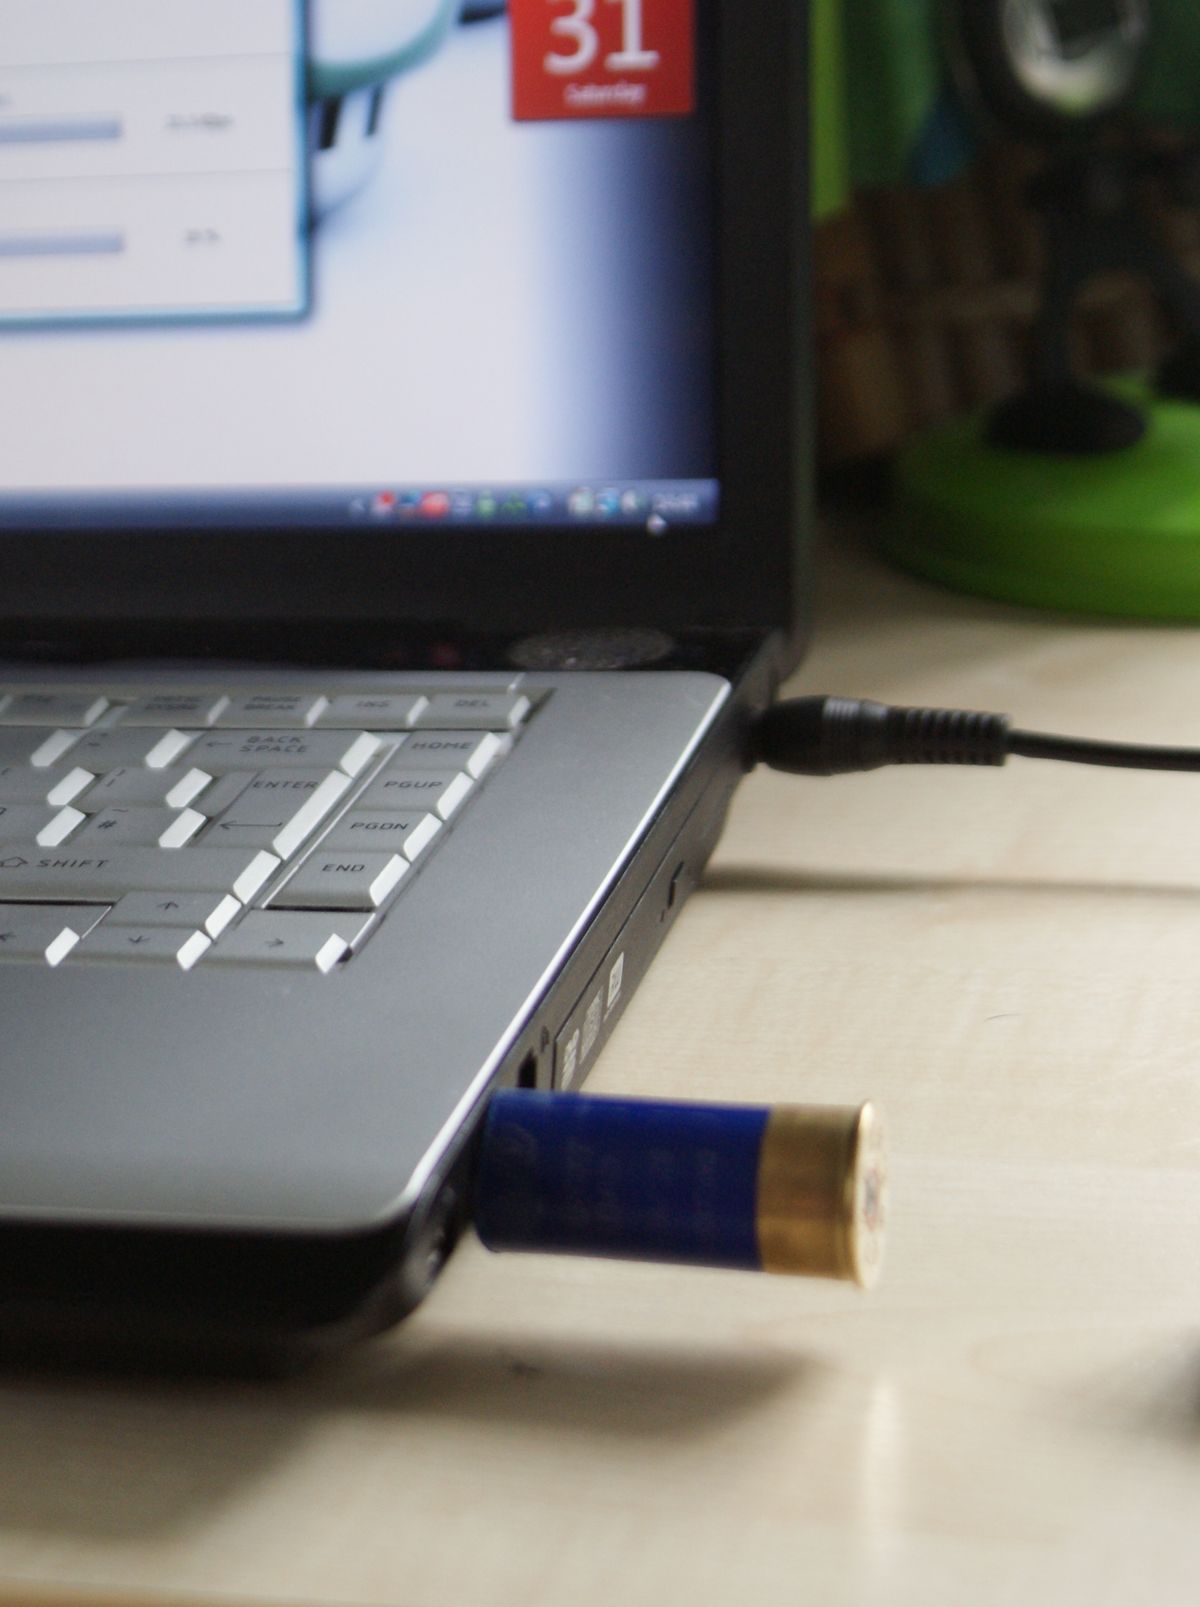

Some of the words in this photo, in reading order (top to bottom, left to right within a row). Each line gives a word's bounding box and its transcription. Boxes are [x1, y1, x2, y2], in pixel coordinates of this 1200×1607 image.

[544, 0, 660, 75] 31
[453, 699, 491, 708] DEL
[246, 735, 302, 744] BACK
[239, 744, 311, 753] SPACE
[411, 741, 473, 750] HOME
[253, 780, 319, 789] ENTER
[384, 780, 443, 789] PGUP
[350, 822, 409, 831] PGDN
[36, 859, 109, 868] SHIFT
[321, 863, 366, 872] END
